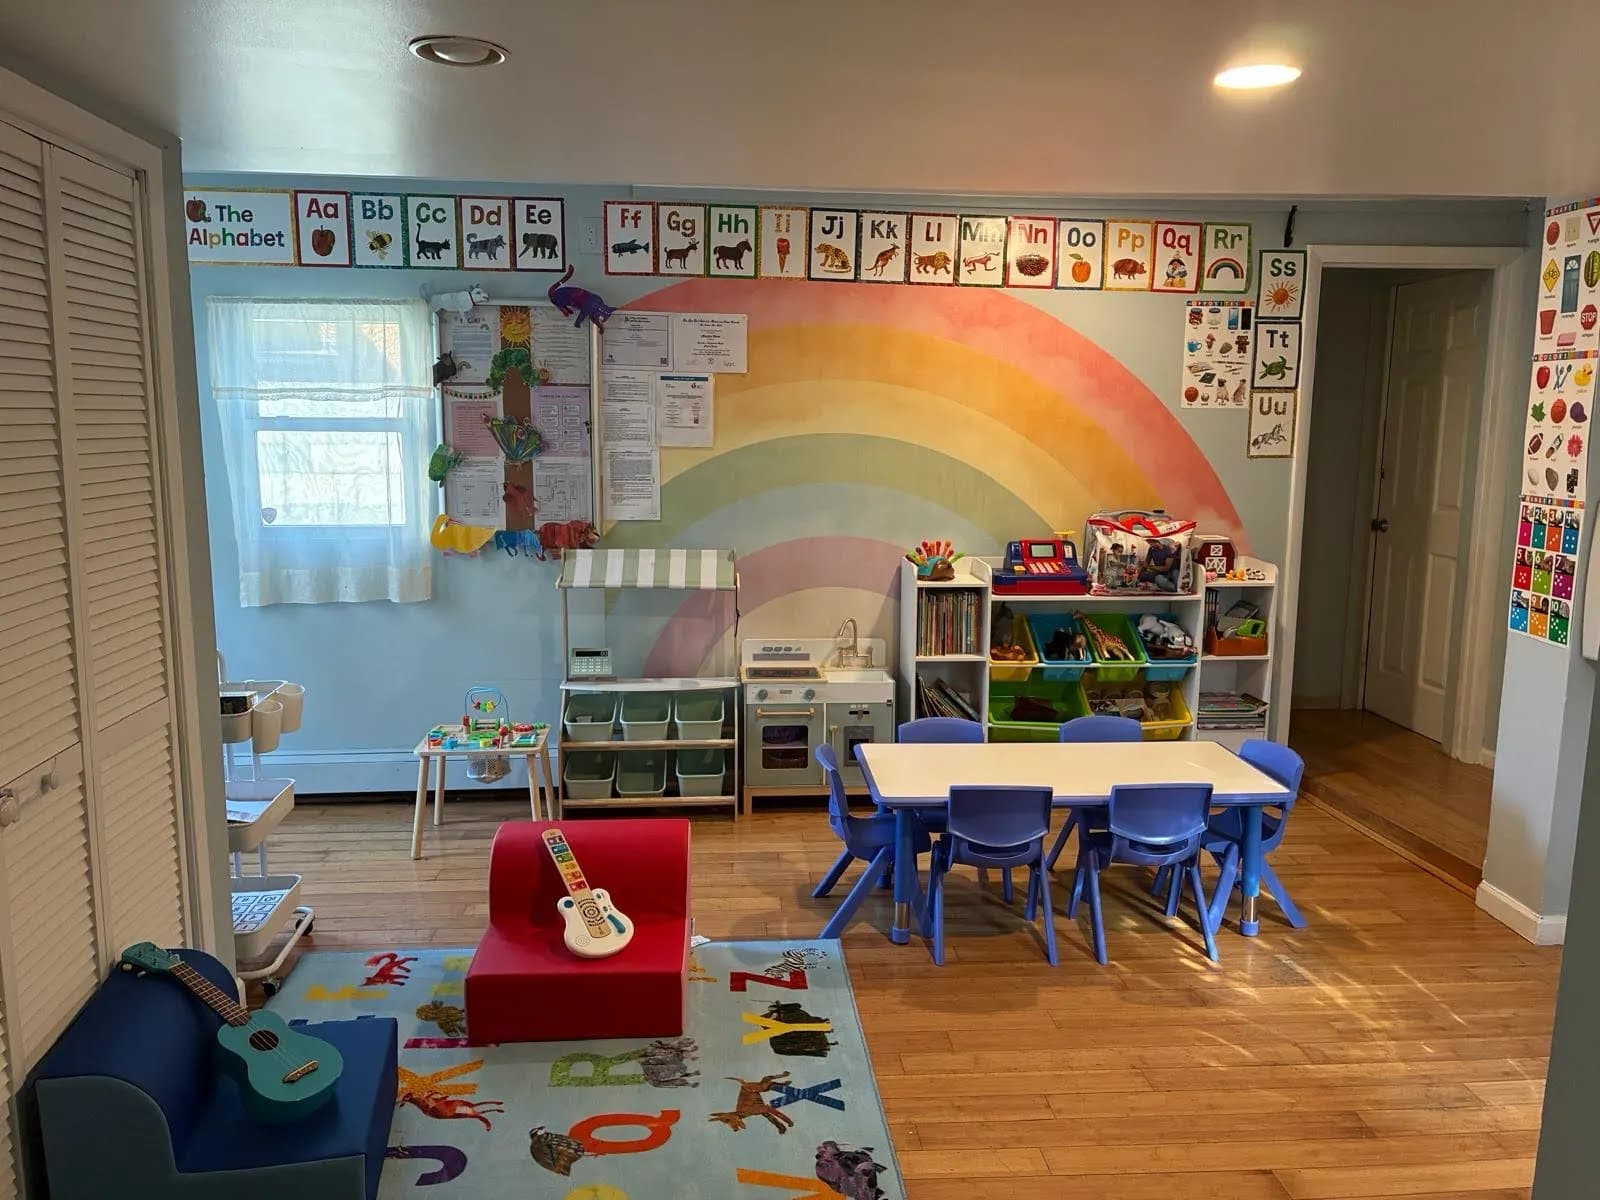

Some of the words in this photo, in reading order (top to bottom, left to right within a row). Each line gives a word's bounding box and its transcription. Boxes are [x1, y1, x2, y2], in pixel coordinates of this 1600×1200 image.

[215, 205, 253, 223] The
[306, 198, 339, 219] Aa
[362, 199, 393, 219] Bb
[416, 203, 447, 223] Cc
[471, 205, 501, 226] Dd
[527, 205, 552, 224] Ee
[620, 208, 641, 228] Ff
[667, 210, 696, 236] Gg
[718, 214, 749, 233] Hh
[775, 214, 791, 233] Ii
[821, 216, 844, 239] Jj
[870, 220, 897, 239] Kk
[925, 222, 942, 242] Ll
[963, 222, 1004, 242] Mm
[189, 227, 285, 249] Alphabet
[1018, 224, 1047, 244] Nn
[1067, 228, 1095, 247] Oo
[1117, 228, 1144, 251] Pp
[1163, 228, 1192, 255] Qq
[1214, 229, 1242, 249] Rr
[1270, 258, 1296, 277] Ss
[1581, 312, 1597, 323] STOP
[1266, 330, 1289, 348] Tt
[1259, 396, 1287, 415] Uu
[1522, 506, 1527, 517] 1
[1535, 509, 1540, 519] 2
[1549, 511, 1555, 521] 3
[1566, 512, 1572, 525] 4
[1517, 549, 1522, 559] 5
[1535, 553, 1541, 563] 6
[1556, 556, 1562, 567] 7
[1512, 591, 1517, 601] 8
[1531, 596, 1536, 607] 9
[1551, 600, 1559, 611] 10
[729, 970, 808, 992] Z
[741, 1012, 832, 1046] Y
[549, 1049, 646, 1087] R
[769, 1078, 845, 1111] X
[568, 1109, 681, 1155] Q
[384, 1145, 468, 1187] J
